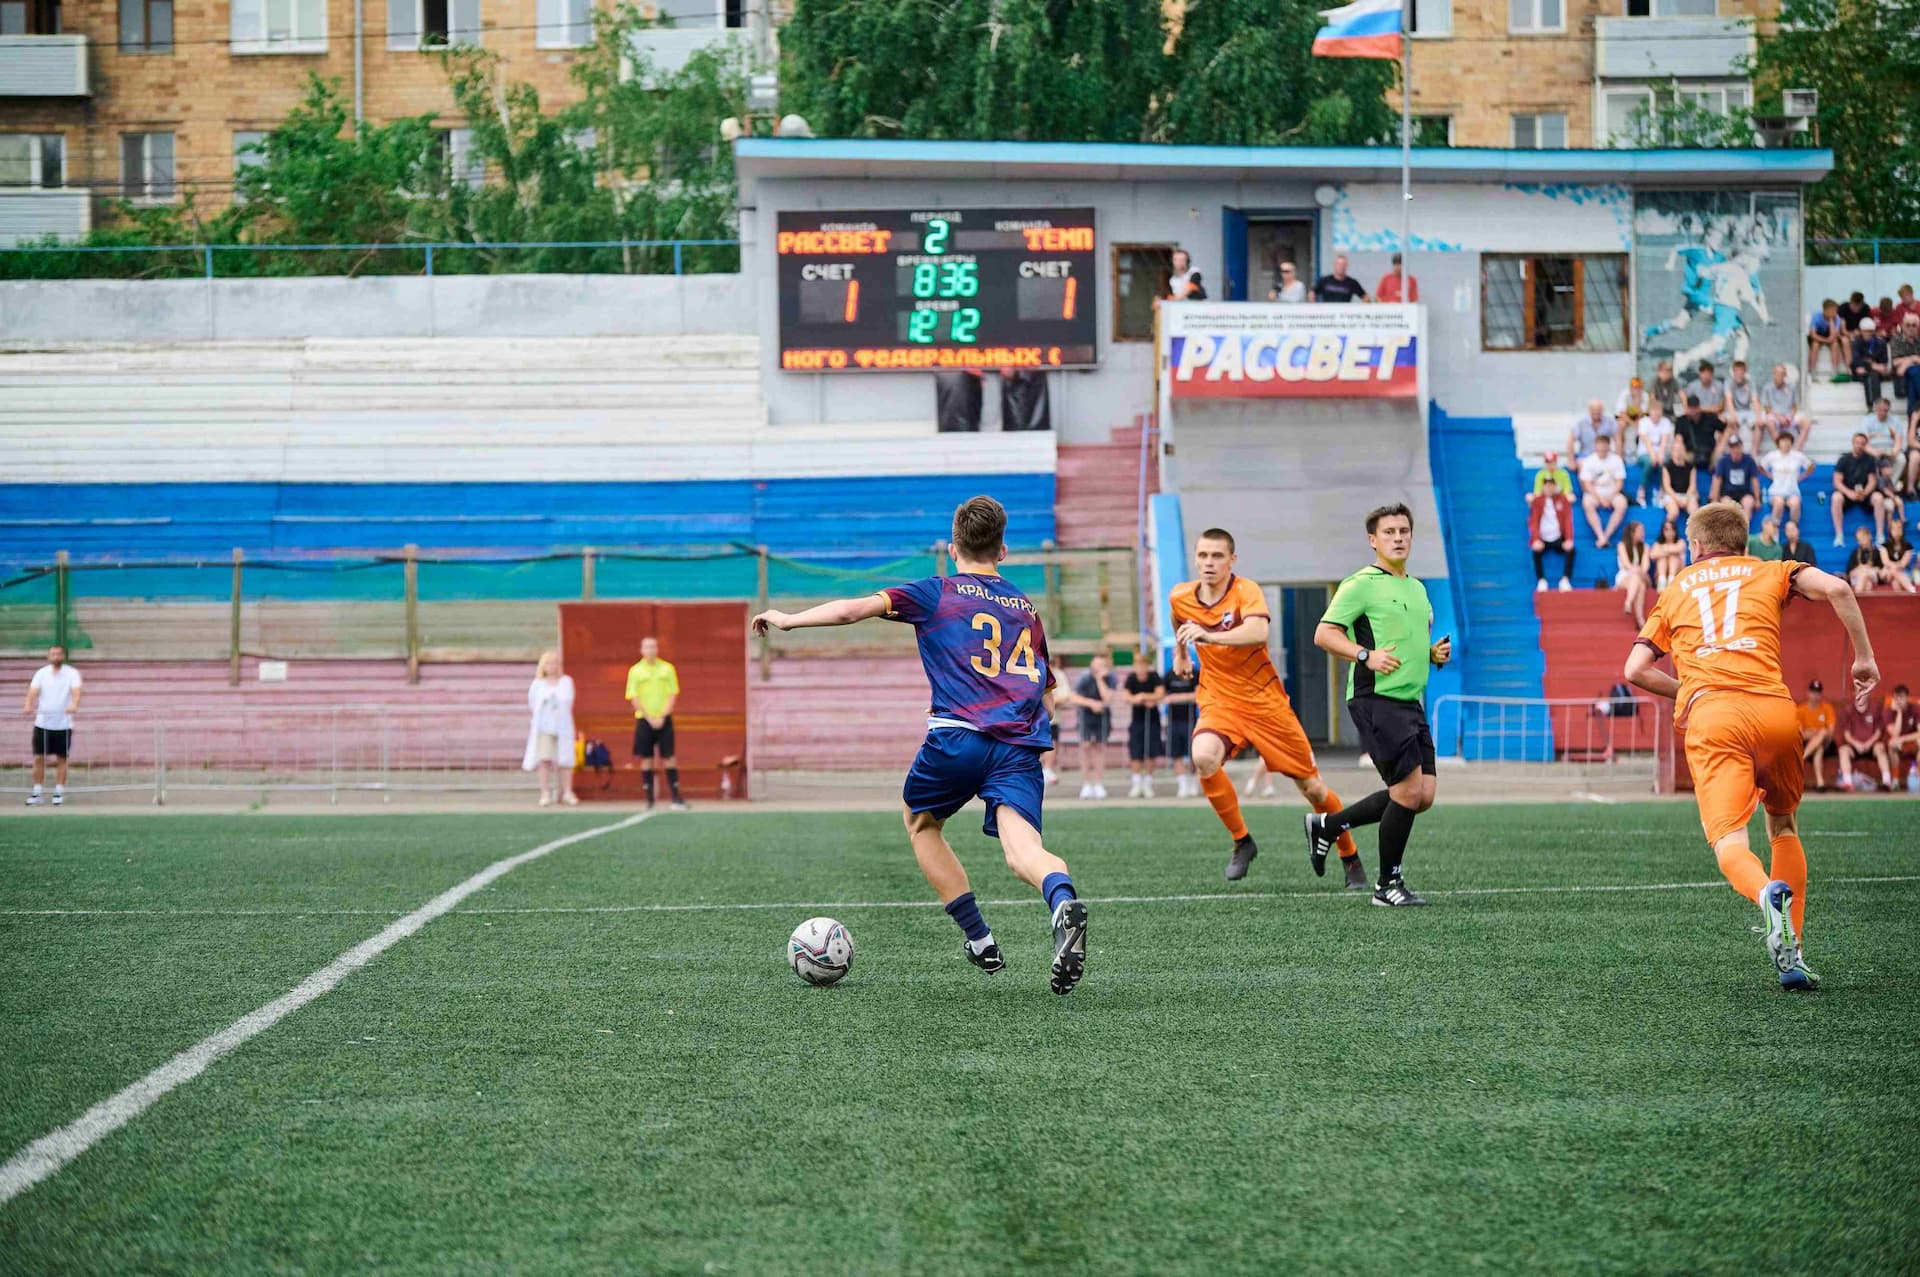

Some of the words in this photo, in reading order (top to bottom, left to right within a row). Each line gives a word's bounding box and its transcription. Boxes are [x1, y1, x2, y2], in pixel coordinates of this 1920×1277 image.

[778, 230, 892, 254] РАССВЕТ
[925, 219, 949, 254] 2
[1022, 227, 1094, 252] ТЕМП
[802, 263, 856, 280] СЧЕТ
[1019, 261, 1072, 278] СЧЕТ
[845, 279, 859, 322] 1
[1062, 277, 1077, 320] 1
[1176, 334, 1411, 382] РАССВЕТ
[1680, 565, 1753, 592] КУЗЬКИН
[1691, 580, 1742, 644] 17
[970, 612, 1041, 684] 34
